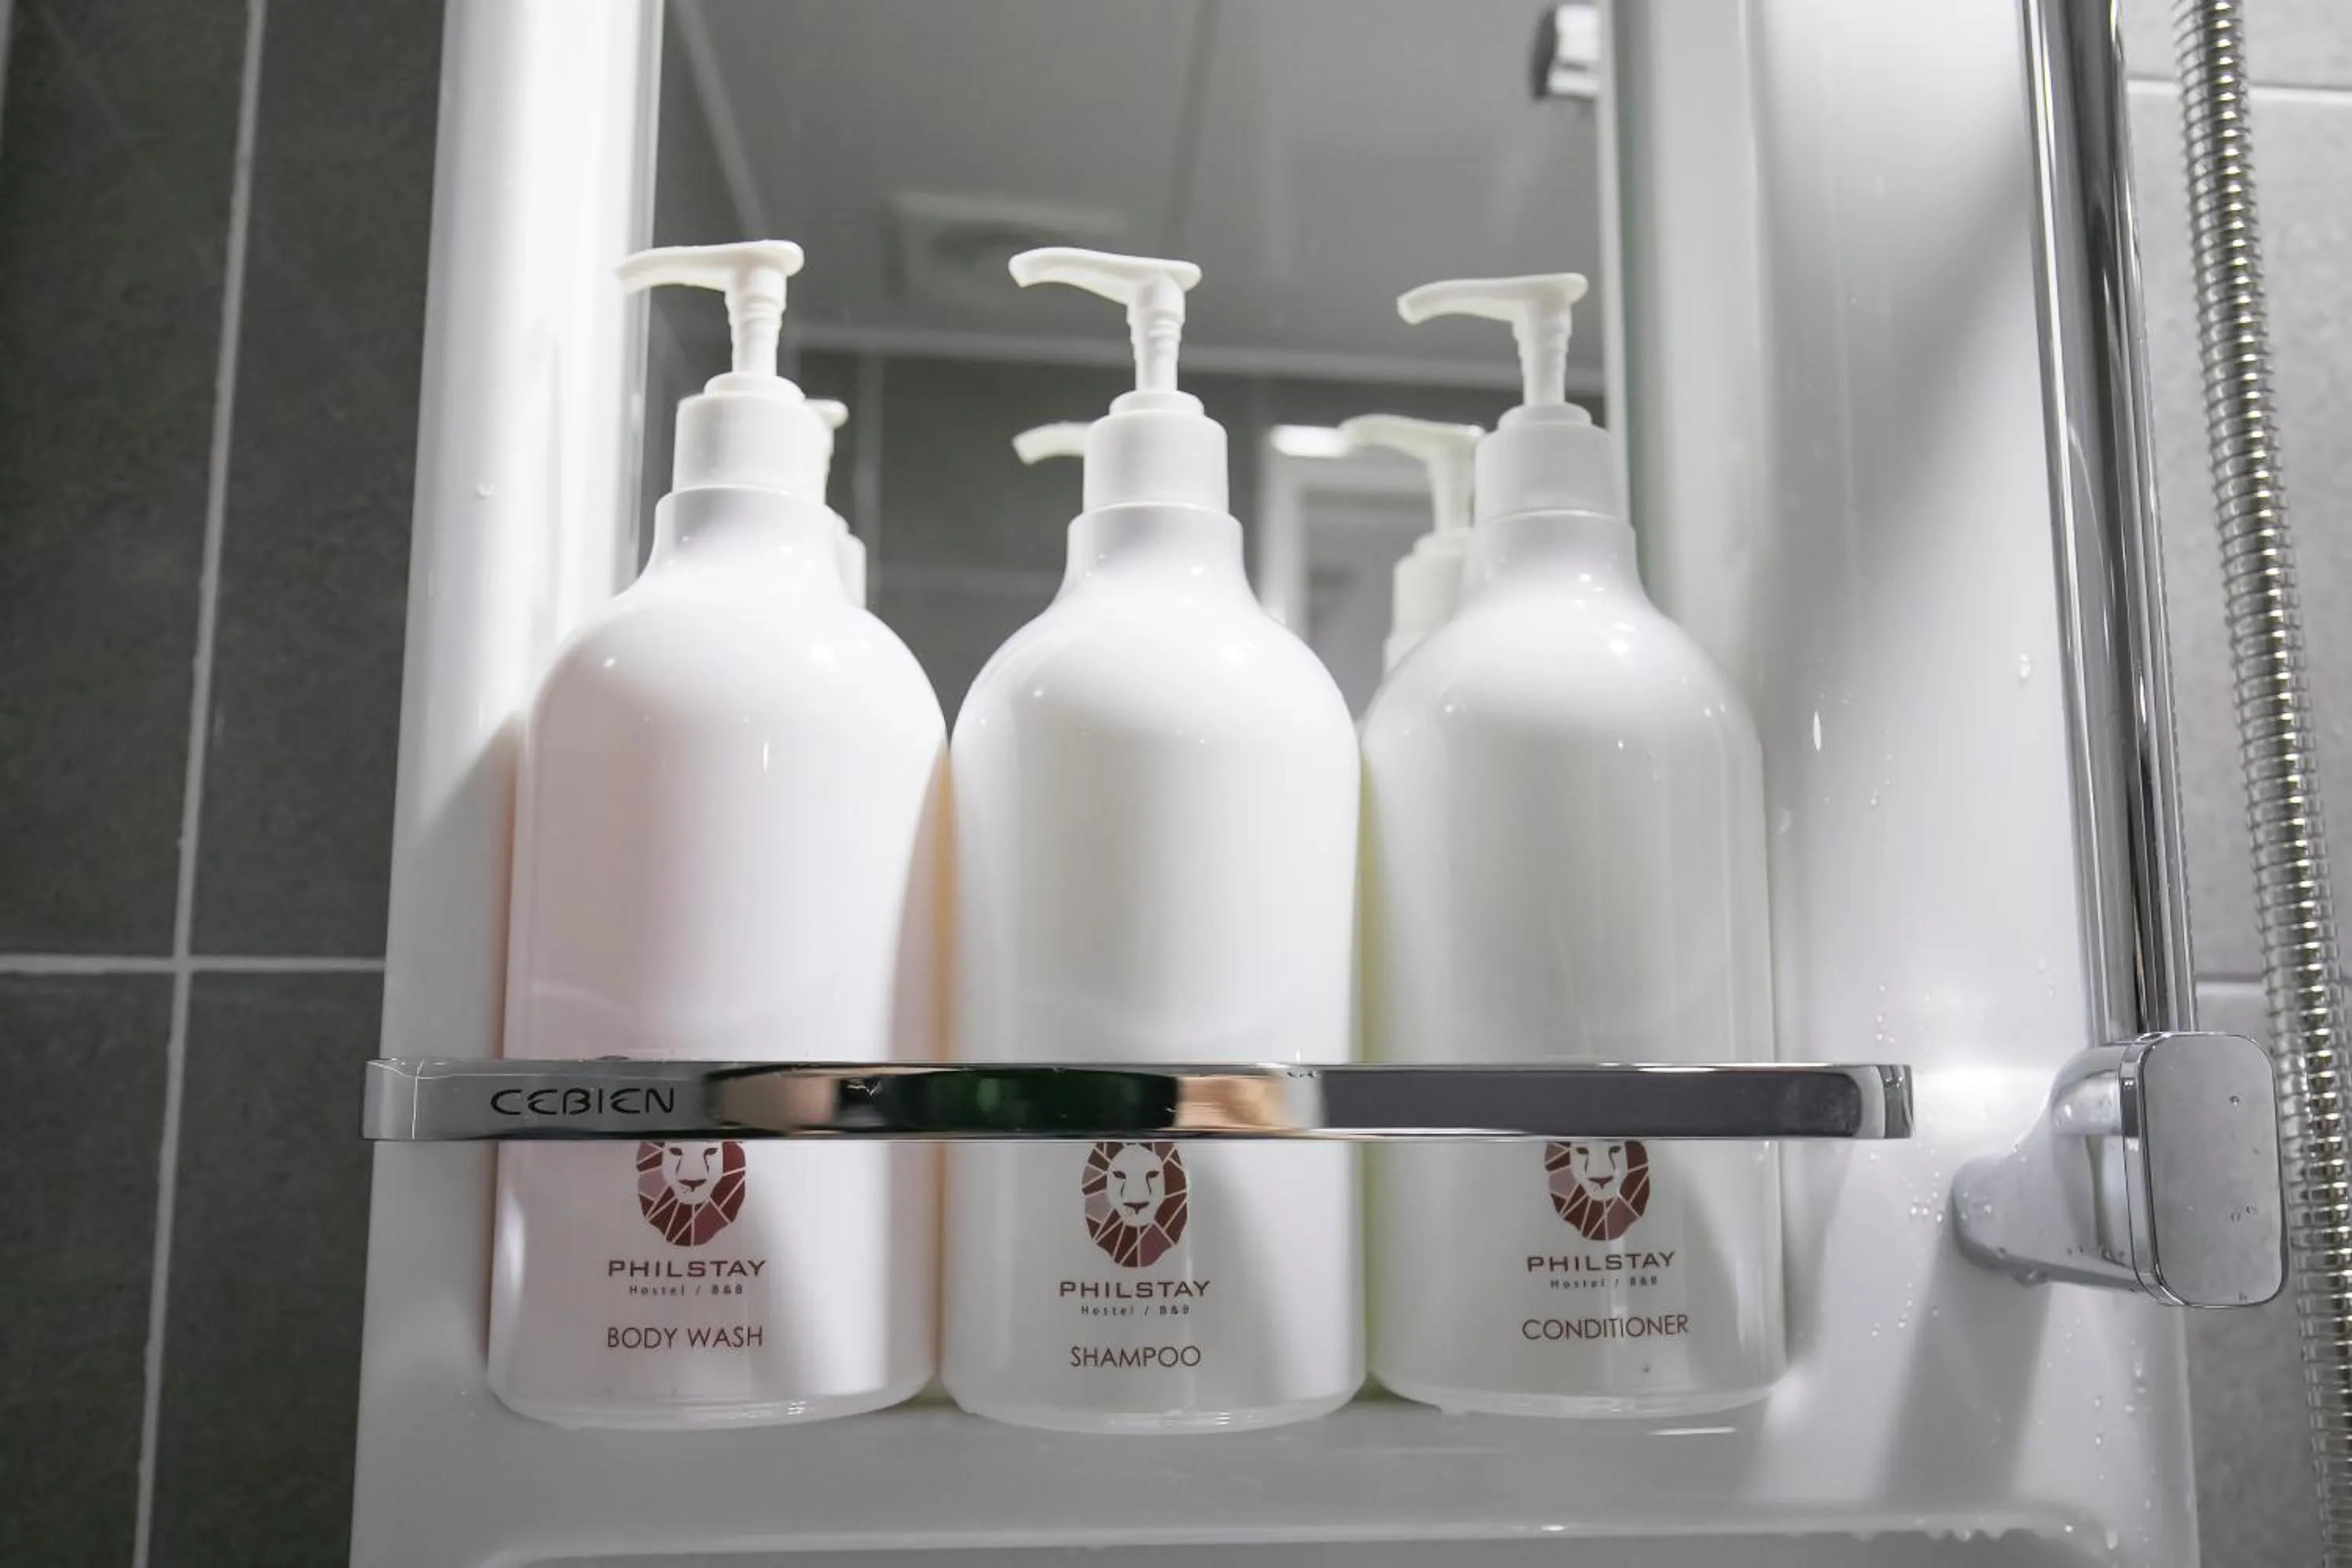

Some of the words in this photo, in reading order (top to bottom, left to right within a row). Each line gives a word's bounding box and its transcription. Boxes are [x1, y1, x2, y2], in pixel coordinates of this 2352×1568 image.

[490, 1087, 675, 1116] CEBIEN
[608, 1260, 767, 1277] PHILSTAY
[1526, 1250, 1676, 1272] PHILSTAY
[630, 1284, 686, 1297] Hostel
[1060, 1280, 1210, 1298] PHILSTAY
[1550, 1278, 1606, 1290] Hostel
[1081, 1305, 1134, 1316] Hostel
[1522, 1314, 1689, 1340] CONDITIONER
[608, 1327, 676, 1348] BODY
[687, 1327, 763, 1348] WASH
[1070, 1345, 1201, 1367] SHAMPOO
